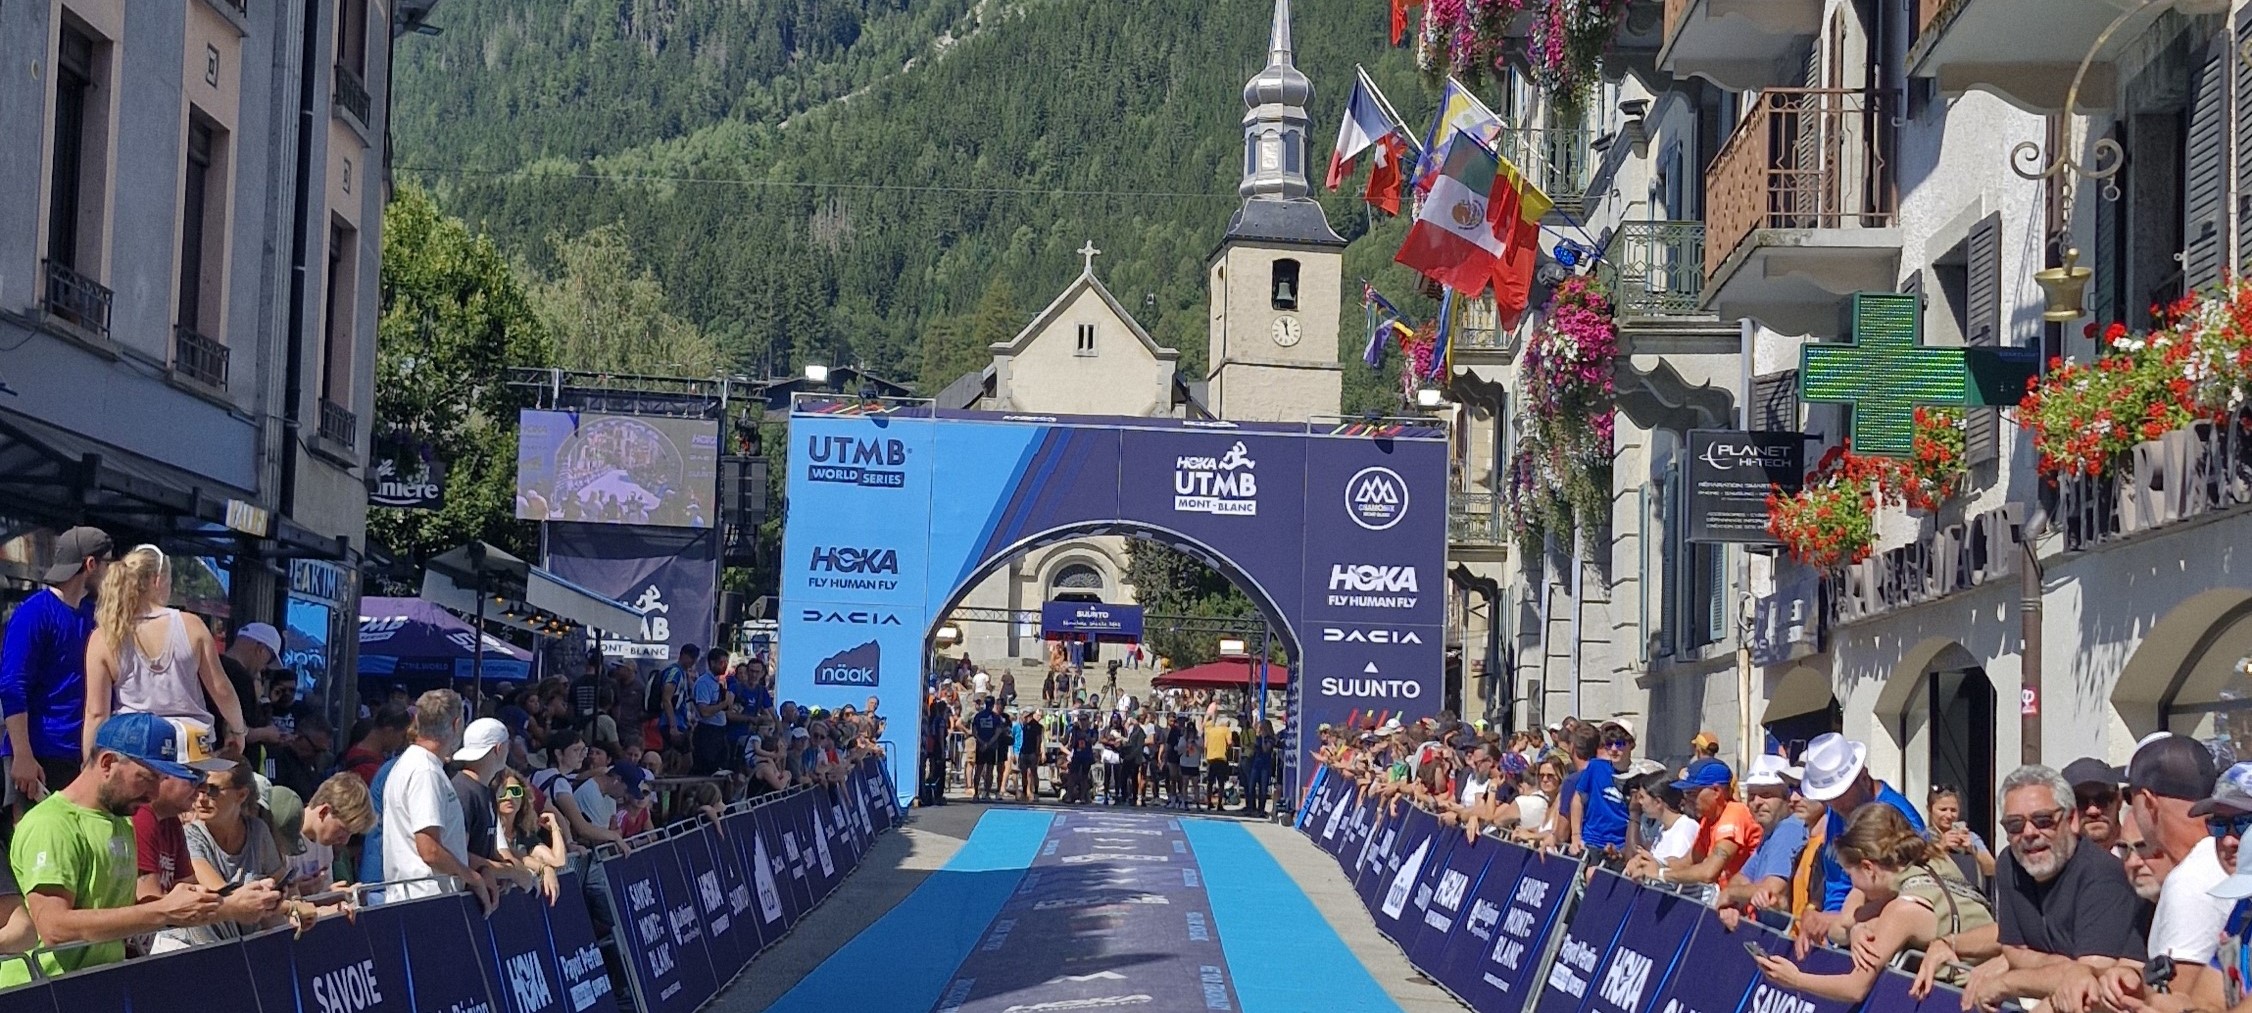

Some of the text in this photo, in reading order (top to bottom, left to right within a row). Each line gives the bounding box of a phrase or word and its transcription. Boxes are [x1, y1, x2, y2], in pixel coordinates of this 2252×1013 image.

[809, 435, 906, 465] UTMB
[1717, 445, 1791, 457] PLANET
[1176, 456, 1217, 470] HOKA
[1739, 458, 1792, 468] HI-TECH
[812, 468, 901, 484] WORLD SERIES
[1175, 470, 1257, 498] UTMB
[809, 546, 898, 574] HOKA
[809, 577, 898, 590] FLY HUMAN FLY
[1328, 564, 1418, 592] HOKA
[1328, 595, 1417, 608] FLY HUMAN FLY
[803, 610, 902, 625] DACIA
[1323, 628, 1422, 644] DACIA
[822, 664, 873, 683] näak
[1321, 677, 1421, 699] SUUNTO
[1433, 868, 1469, 912] HOKA
[1516, 876, 1550, 909] SAVOIE
[312, 958, 383, 1013] SAVOIE
[505, 950, 553, 1013] HOKA
[1599, 946, 1654, 1013] HOKA
